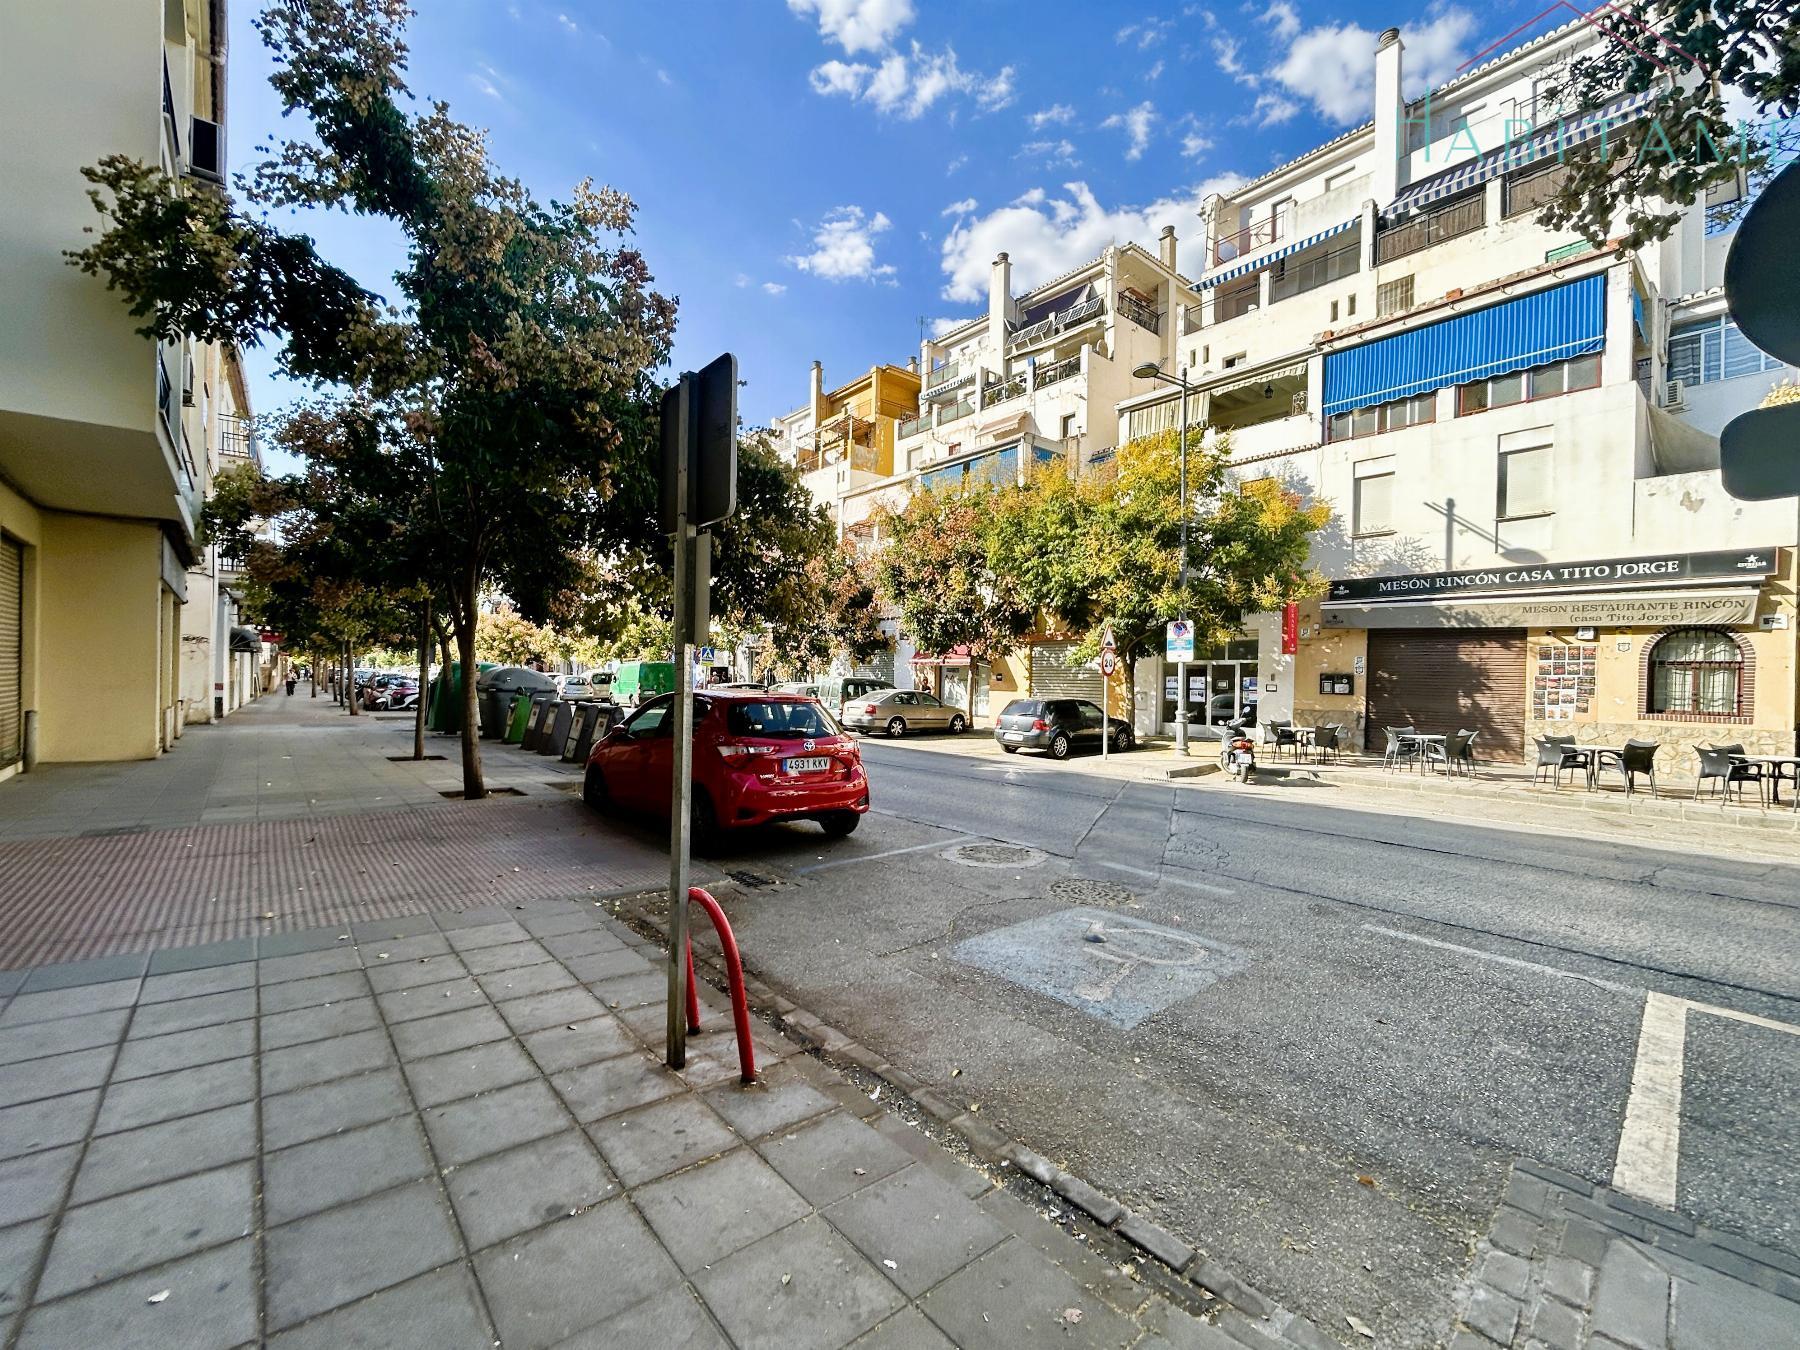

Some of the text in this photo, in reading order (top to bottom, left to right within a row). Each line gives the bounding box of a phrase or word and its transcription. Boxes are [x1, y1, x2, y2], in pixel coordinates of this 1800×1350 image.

[1378, 560, 1679, 592] MESÓN RINCÓN CASA TITO JORGE
[1571, 601, 1679, 613] RESTAURANTE
[1683, 598, 1746, 610] RINCÓN
[1569, 611, 1684, 623] (casa Tito Jorge)
[1104, 658, 1113, 668] 20
[789, 758, 828, 769] 4931 KKV
